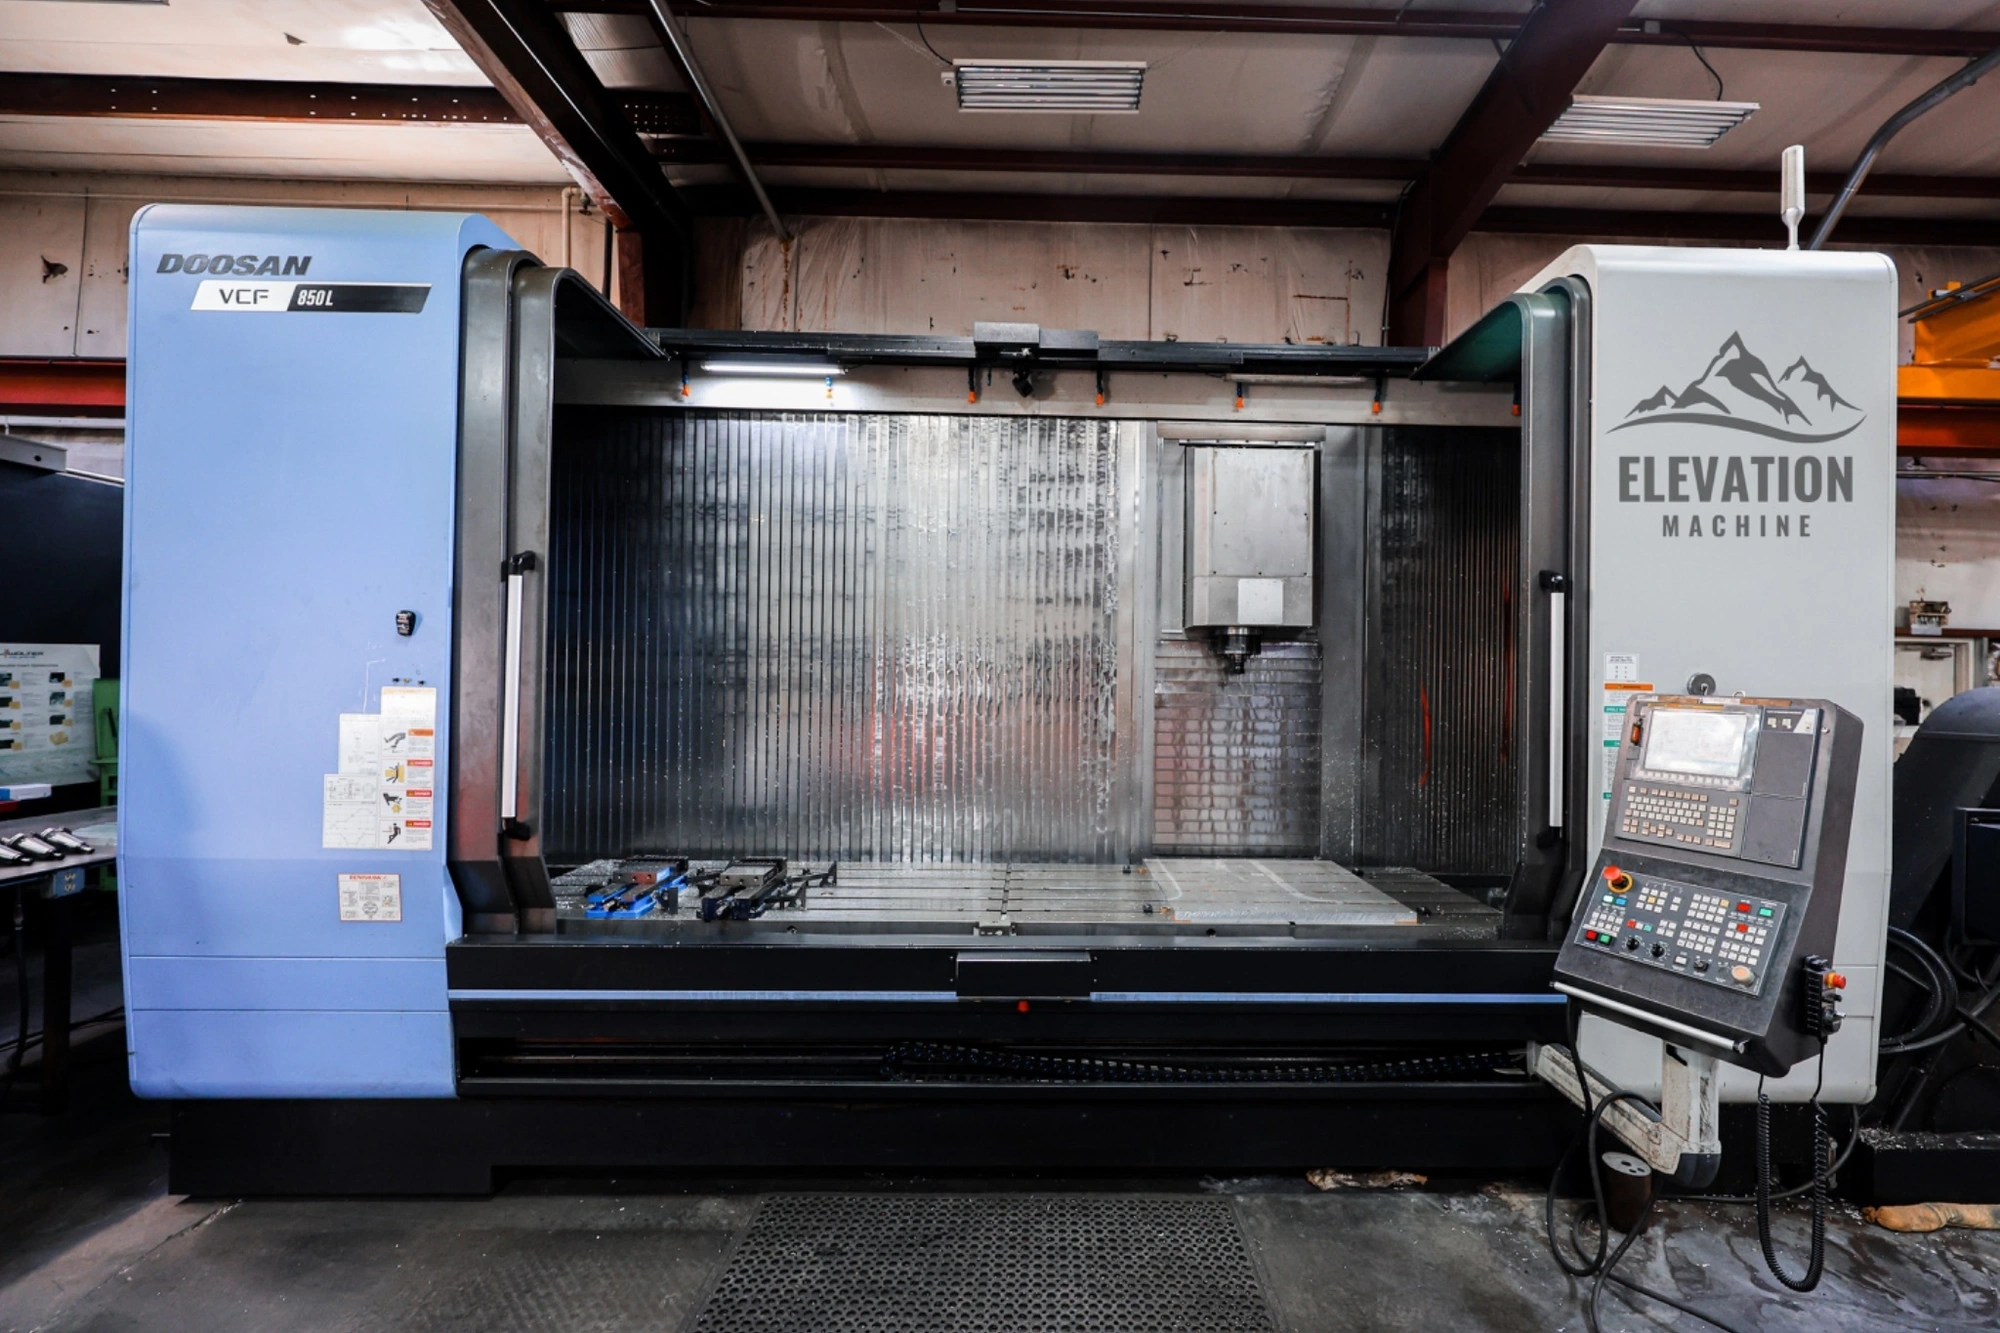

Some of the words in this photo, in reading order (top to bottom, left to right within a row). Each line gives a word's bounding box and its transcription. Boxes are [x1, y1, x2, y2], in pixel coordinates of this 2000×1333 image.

[156, 253, 312, 276] DOOSAN
[219, 288, 269, 305] VCF
[1618, 455, 1853, 503] ELEVATION
[1662, 514, 1811, 538] MACHINE
